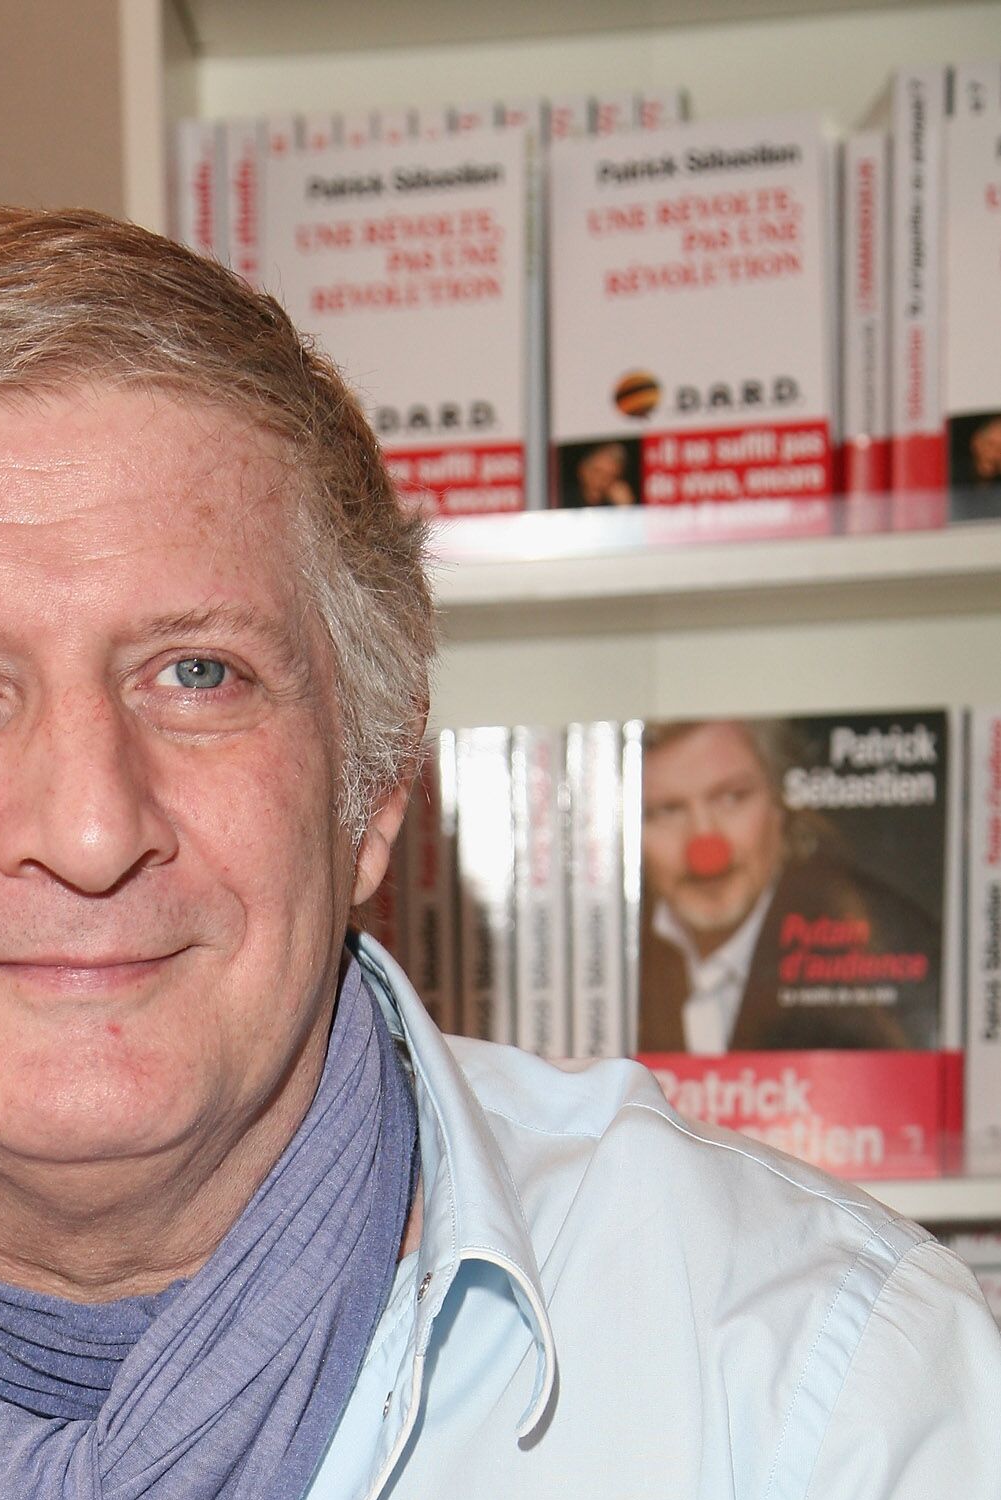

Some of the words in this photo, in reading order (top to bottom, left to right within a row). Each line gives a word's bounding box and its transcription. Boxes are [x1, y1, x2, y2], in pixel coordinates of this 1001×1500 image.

[306, 174, 384, 200] Patrick
[393, 162, 502, 193] Sébastien
[596, 157, 677, 187] Patrick
[685, 143, 801, 175] Sébastien
[296, 222, 352, 252] UNE
[586, 205, 646, 238] UNE
[682, 230, 732, 253] PAS
[738, 221, 798, 247] UNE
[388, 250, 433, 272] PAS
[441, 242, 498, 266] UNE
[605, 252, 802, 298] RÉVOLUTION
[312, 277, 500, 314] RÉVOLUTION
[781, 431, 825, 461] pas
[831, 724, 937, 768] Patrick
[784, 767, 937, 810] Sébastien
[780, 912, 871, 947] Putain
